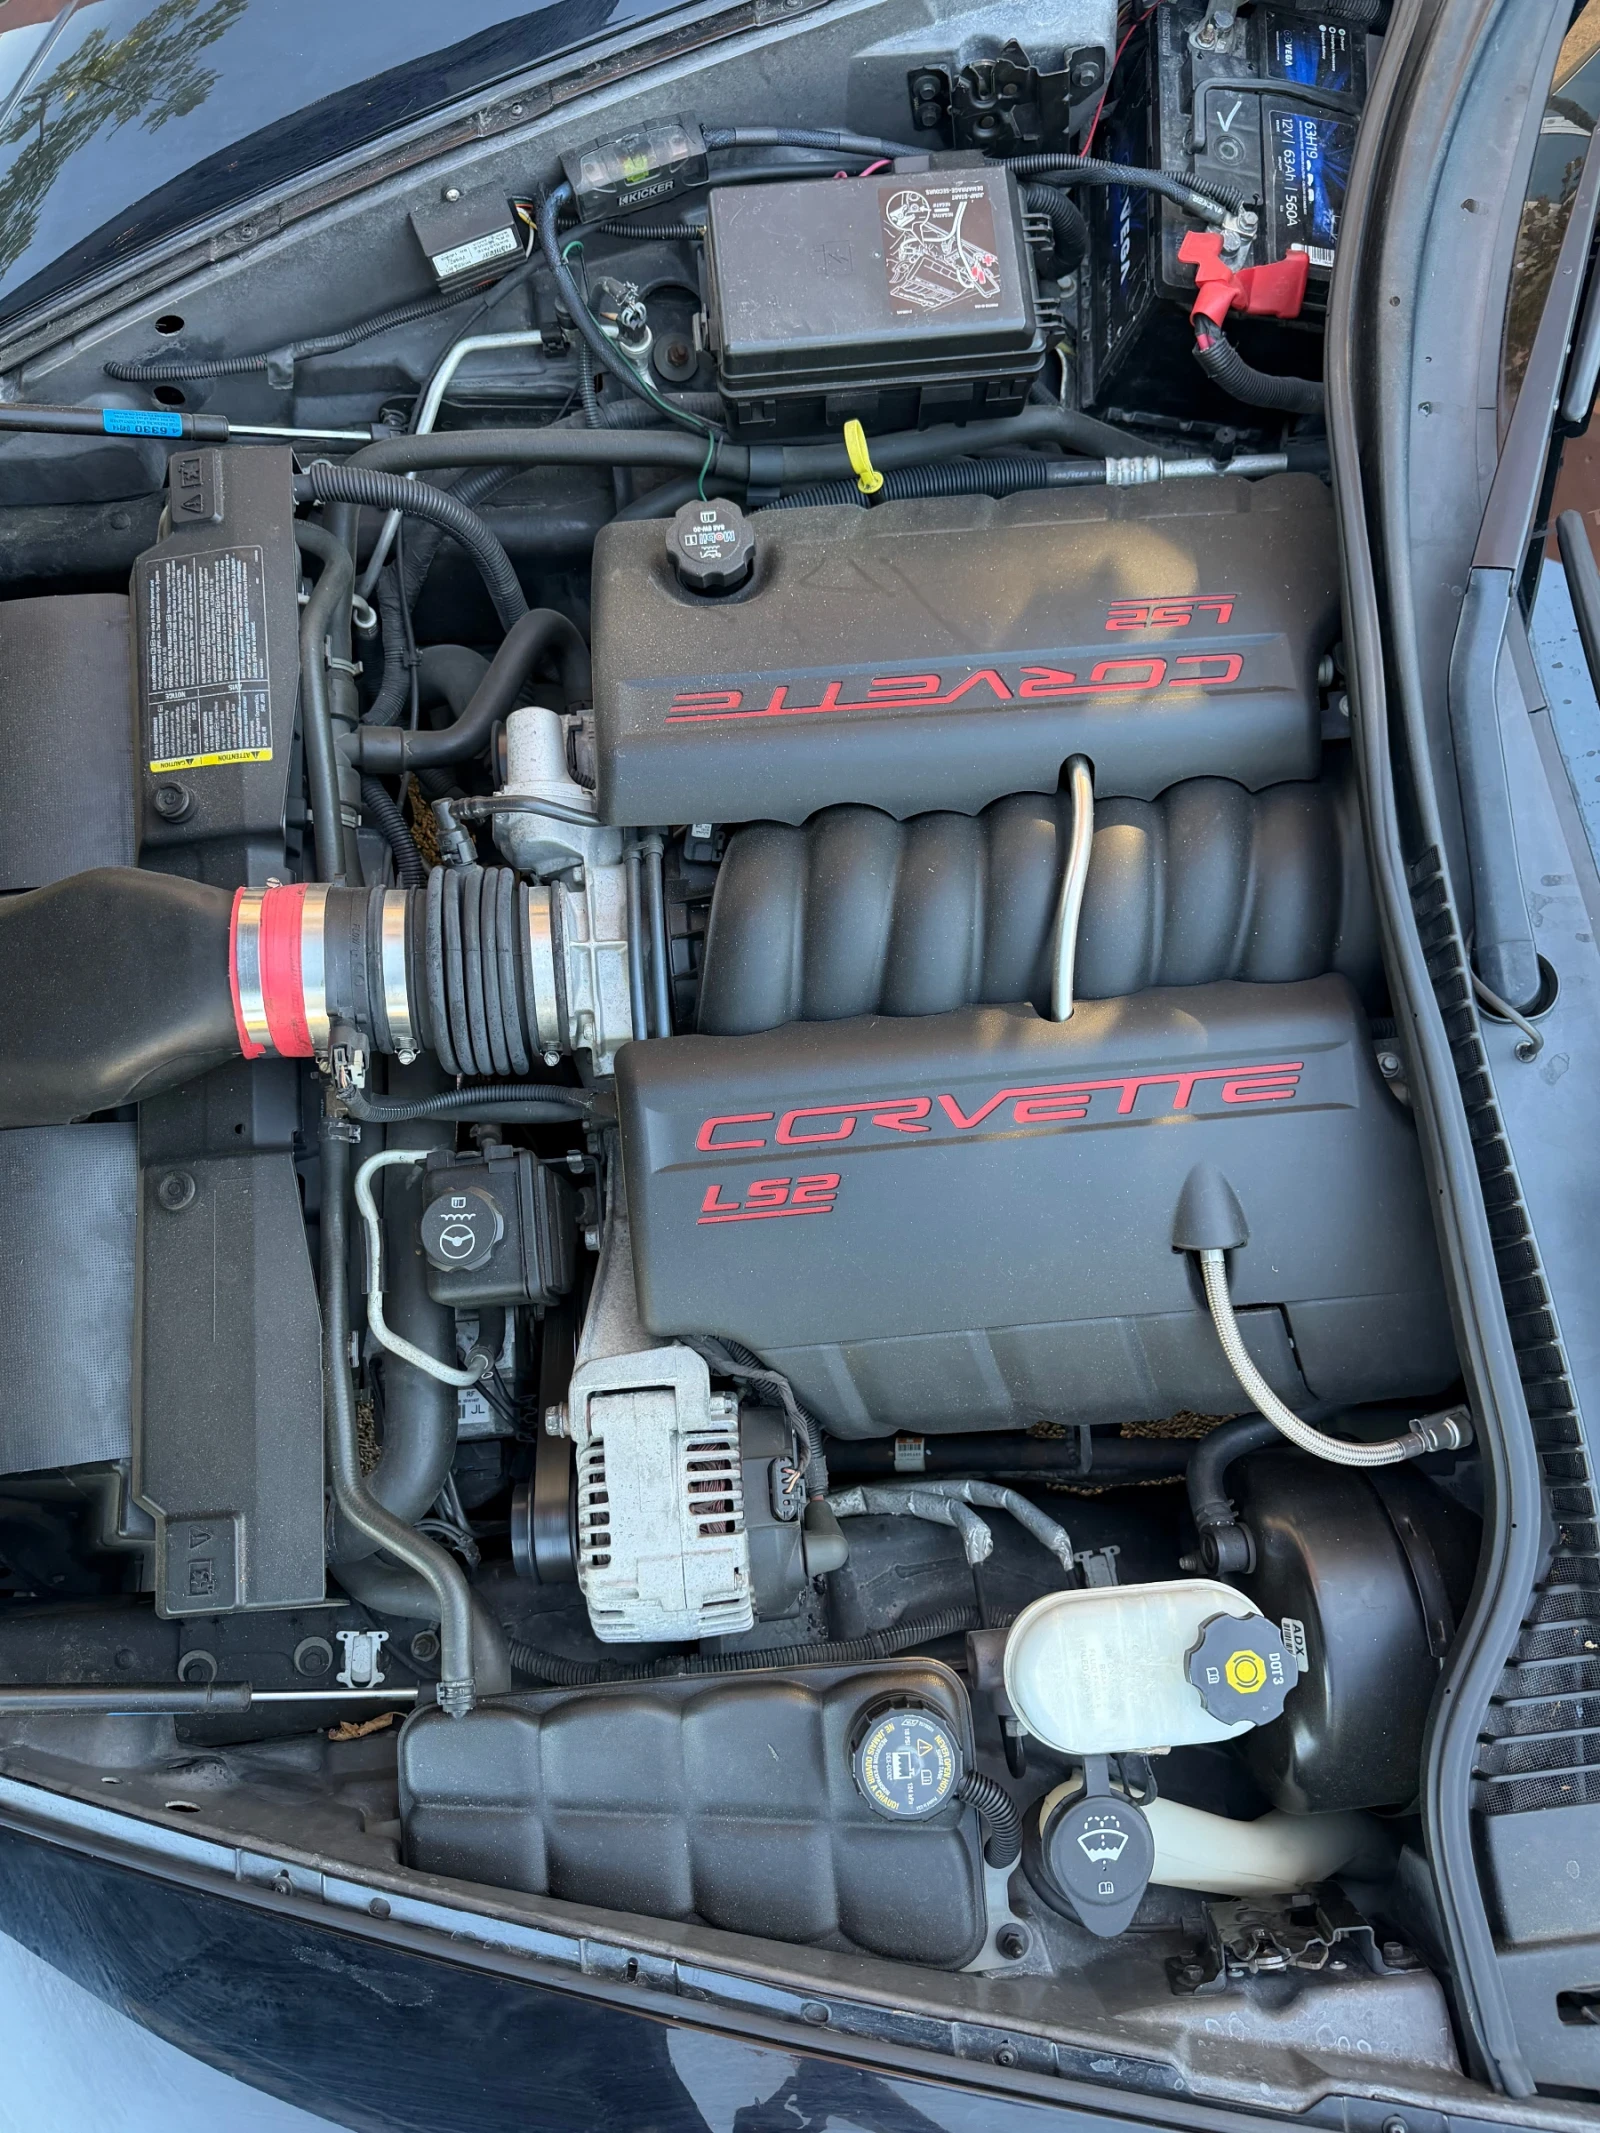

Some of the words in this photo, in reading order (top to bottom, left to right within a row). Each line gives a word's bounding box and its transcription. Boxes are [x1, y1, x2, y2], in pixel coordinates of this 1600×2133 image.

[1284, 43, 1294, 67] VEGA
[1282, 118, 1293, 138] 12V
[1304, 121, 1318, 159] 63H19
[1283, 149, 1297, 181] 63Ah
[629, 180, 674, 203] KICKER
[951, 192, 984, 201] JUMP-START
[1285, 194, 1298, 226] 560A
[1119, 196, 1132, 286] VEGA
[135, 425, 167, 435] 6330
[699, 530, 735, 545] Mobil
[1105, 598, 1236, 631] LS2
[164, 690, 185, 699] NOTICE
[665, 653, 1244, 723] CORVETTE
[161, 760, 186, 769] CAUTION
[218, 752, 251, 761] ATTENTION
[696, 1062, 1304, 1152] CORVETTE
[700, 1172, 843, 1214] LS2
[1292, 1623, 1305, 1656] ADX
[1269, 1652, 1282, 1676] DOT
[1272, 1676, 1284, 1686] 3
[883, 1722, 896, 1734] NE
[904, 1728, 910, 1736] 18
[866, 1729, 886, 1756] JAMAIS
[933, 1734, 950, 1758] NEVER
[943, 1757, 952, 1777] OPEN
[865, 1757, 874, 1784] OUVRIR
